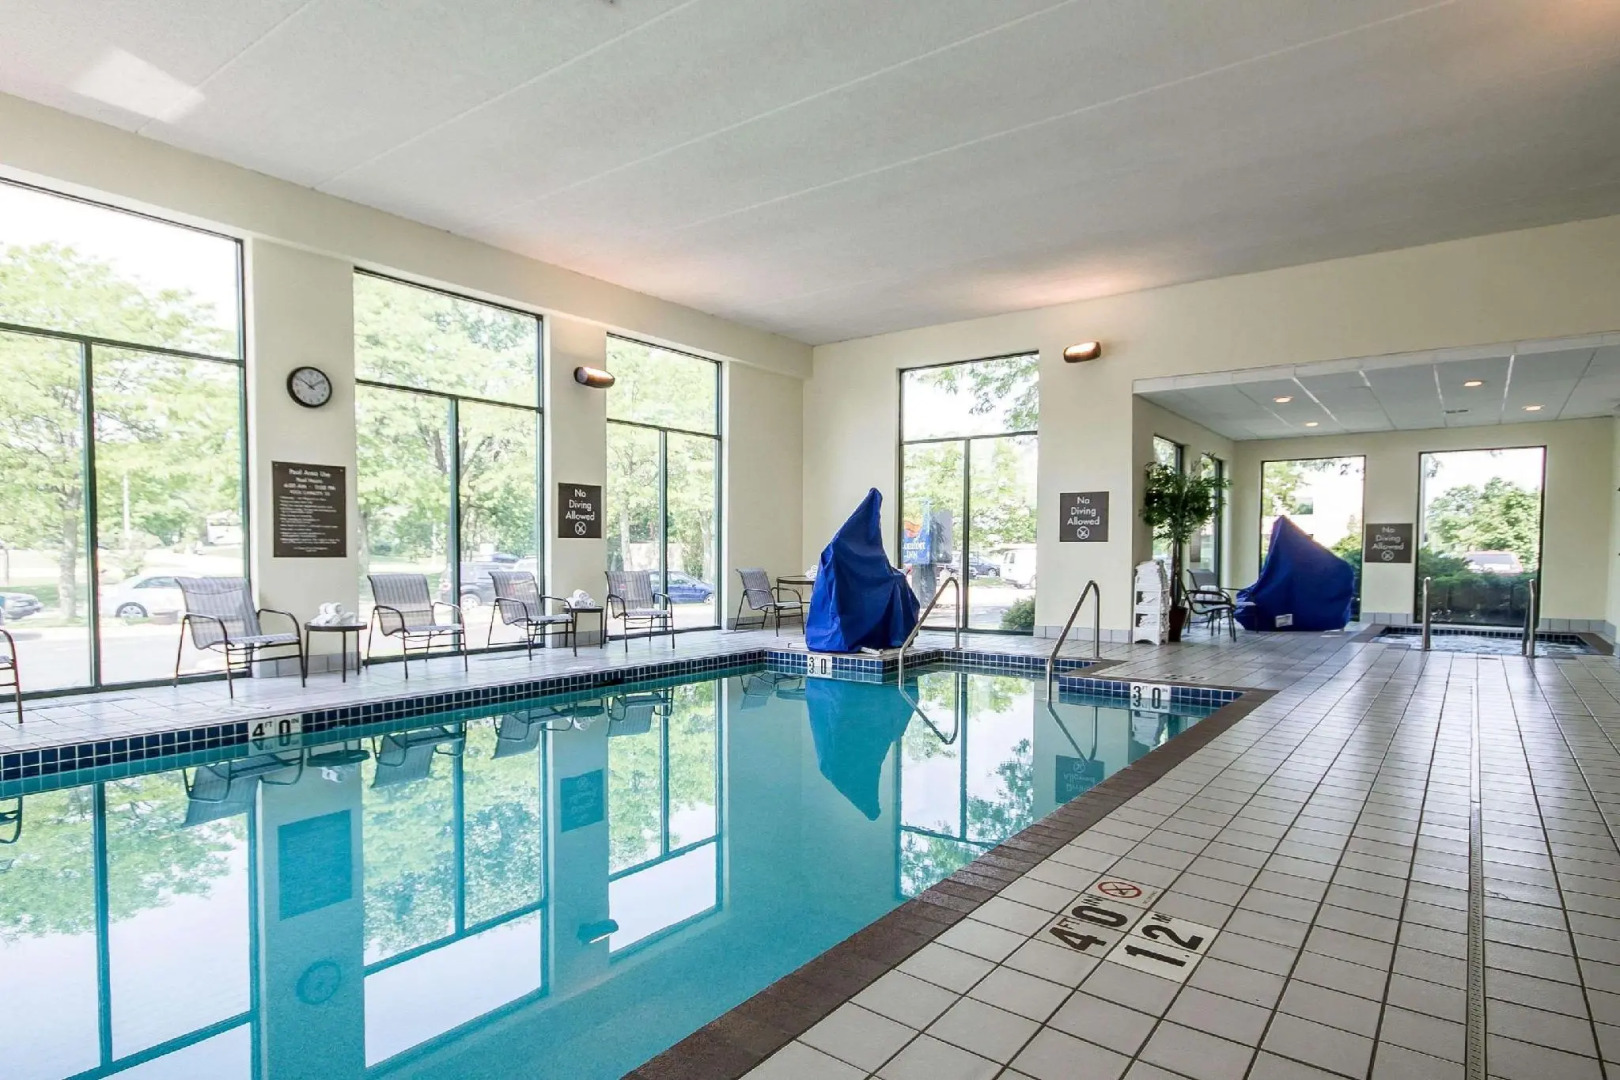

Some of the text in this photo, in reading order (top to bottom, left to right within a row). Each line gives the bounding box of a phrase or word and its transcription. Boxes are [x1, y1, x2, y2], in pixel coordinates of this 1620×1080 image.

[574, 489, 586, 497] No
[569, 499, 591, 511] Diving
[1077, 496, 1090, 504] No
[565, 510, 595, 520] Allowed
[1071, 506, 1096, 517] Diving
[1066, 516, 1100, 526] Allowed
[1375, 534, 1401, 543] Diving
[1371, 542, 1405, 550] Allowed
[252, 722, 266, 737] 4
[279, 719, 291, 736] 0
[1071, 905, 1128, 927] 0
[1056, 917, 1080, 930] FT
[1049, 926, 1108, 951] 4
